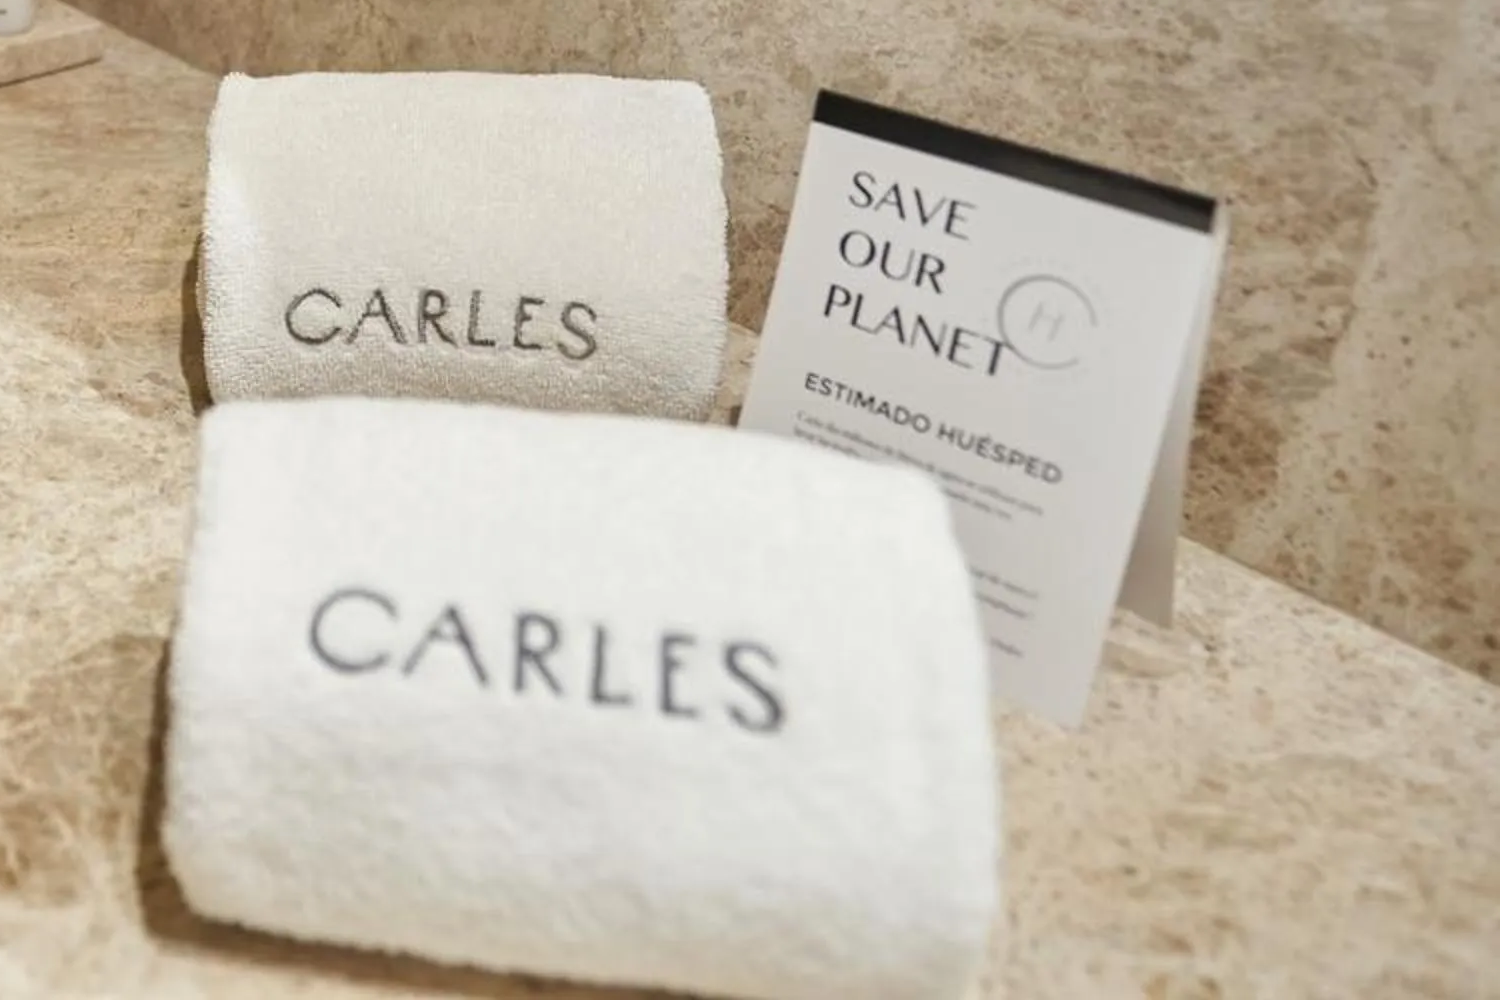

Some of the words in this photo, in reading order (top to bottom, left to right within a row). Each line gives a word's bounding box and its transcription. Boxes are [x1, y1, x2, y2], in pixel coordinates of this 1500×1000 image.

[848, 171, 977, 240] SAVE
[839, 230, 946, 294] OUR
[284, 287, 599, 362] CARLES
[823, 284, 1010, 376] PLANET
[803, 371, 932, 434] ESTIMADO
[938, 423, 1062, 484] HUÉSPED
[309, 587, 786, 733] CARLES
